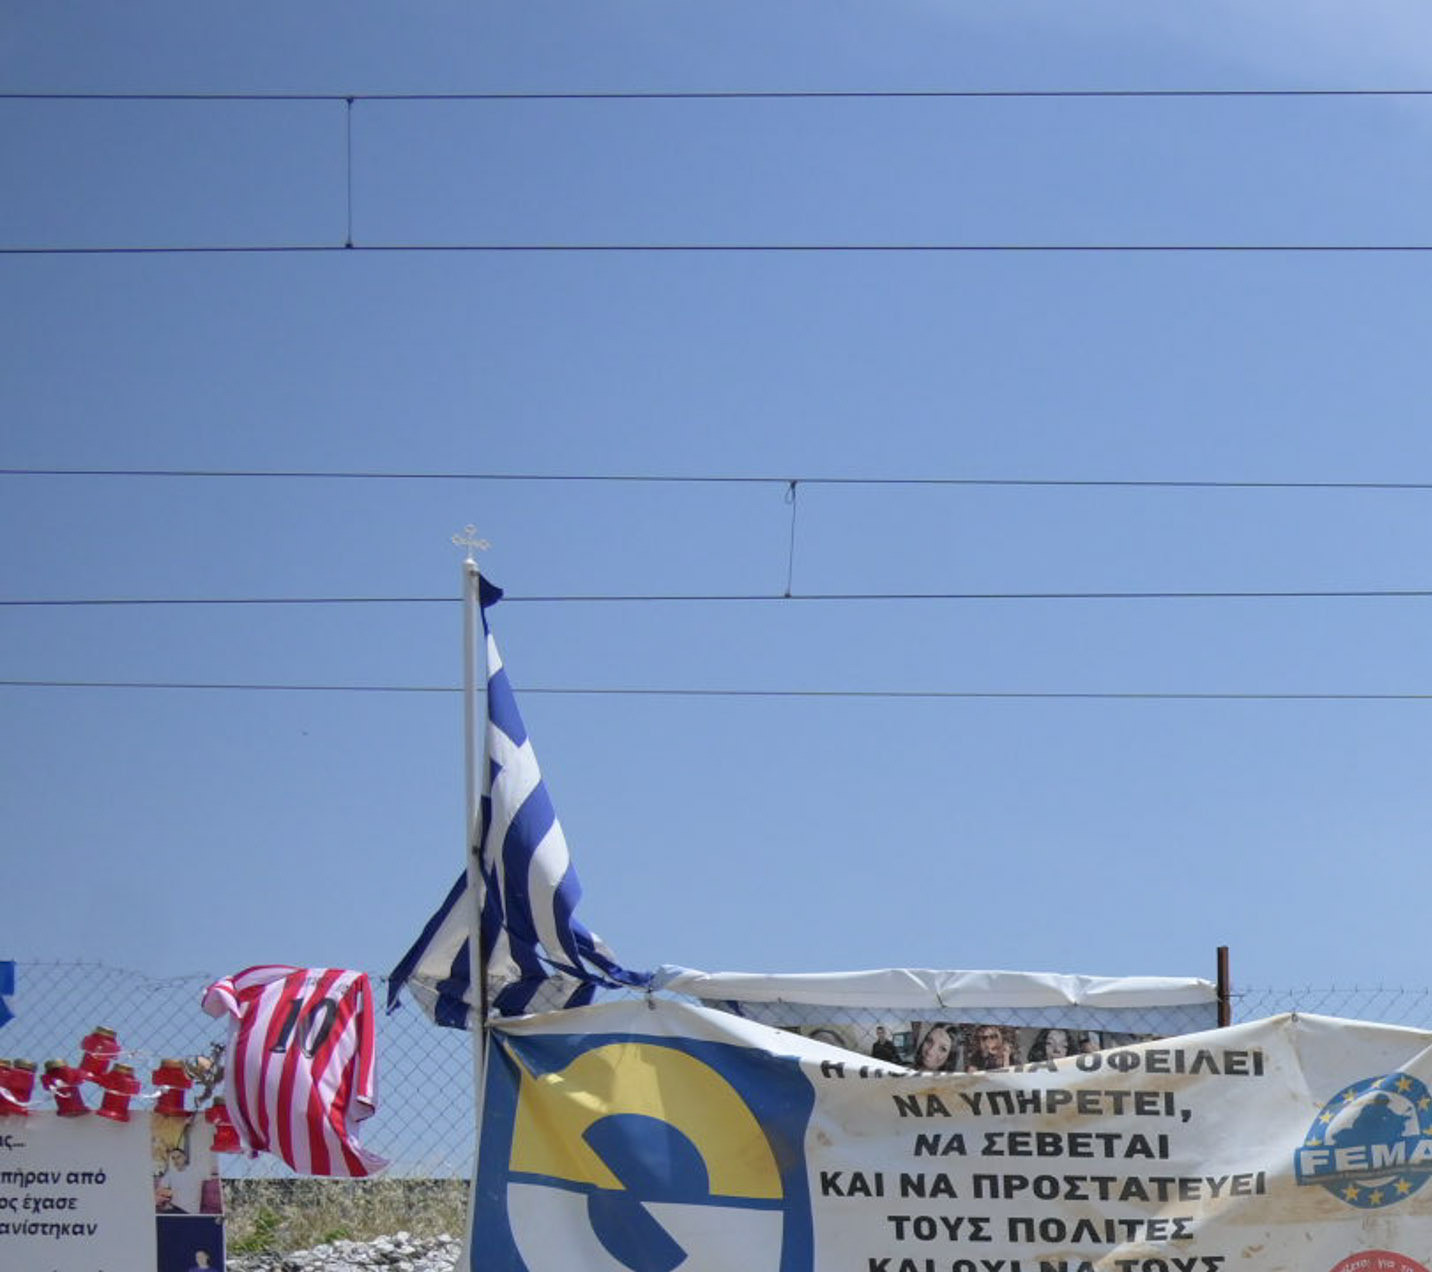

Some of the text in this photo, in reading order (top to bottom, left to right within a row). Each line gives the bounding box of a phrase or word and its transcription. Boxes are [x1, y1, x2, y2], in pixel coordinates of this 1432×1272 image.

[269, 997, 338, 1059] 10
[892, 1089, 1193, 1122] ΝΑ ΥΠΗΡΕΤΕΙ,
[913, 1132, 1170, 1161] ΝΑ ΣΕΒΕΤΑΙ
[66, 1169, 107, 1185] από
[820, 1170, 1267, 1203] ΚΑΙ ΝΑ ΠΡΟΣΤΑΤΕΥΕΙ
[23, 1196, 78, 1216] έχασε
[887, 1214, 1195, 1244] ΤΟΥΣ ΠΟΛΙΤΕΣ
